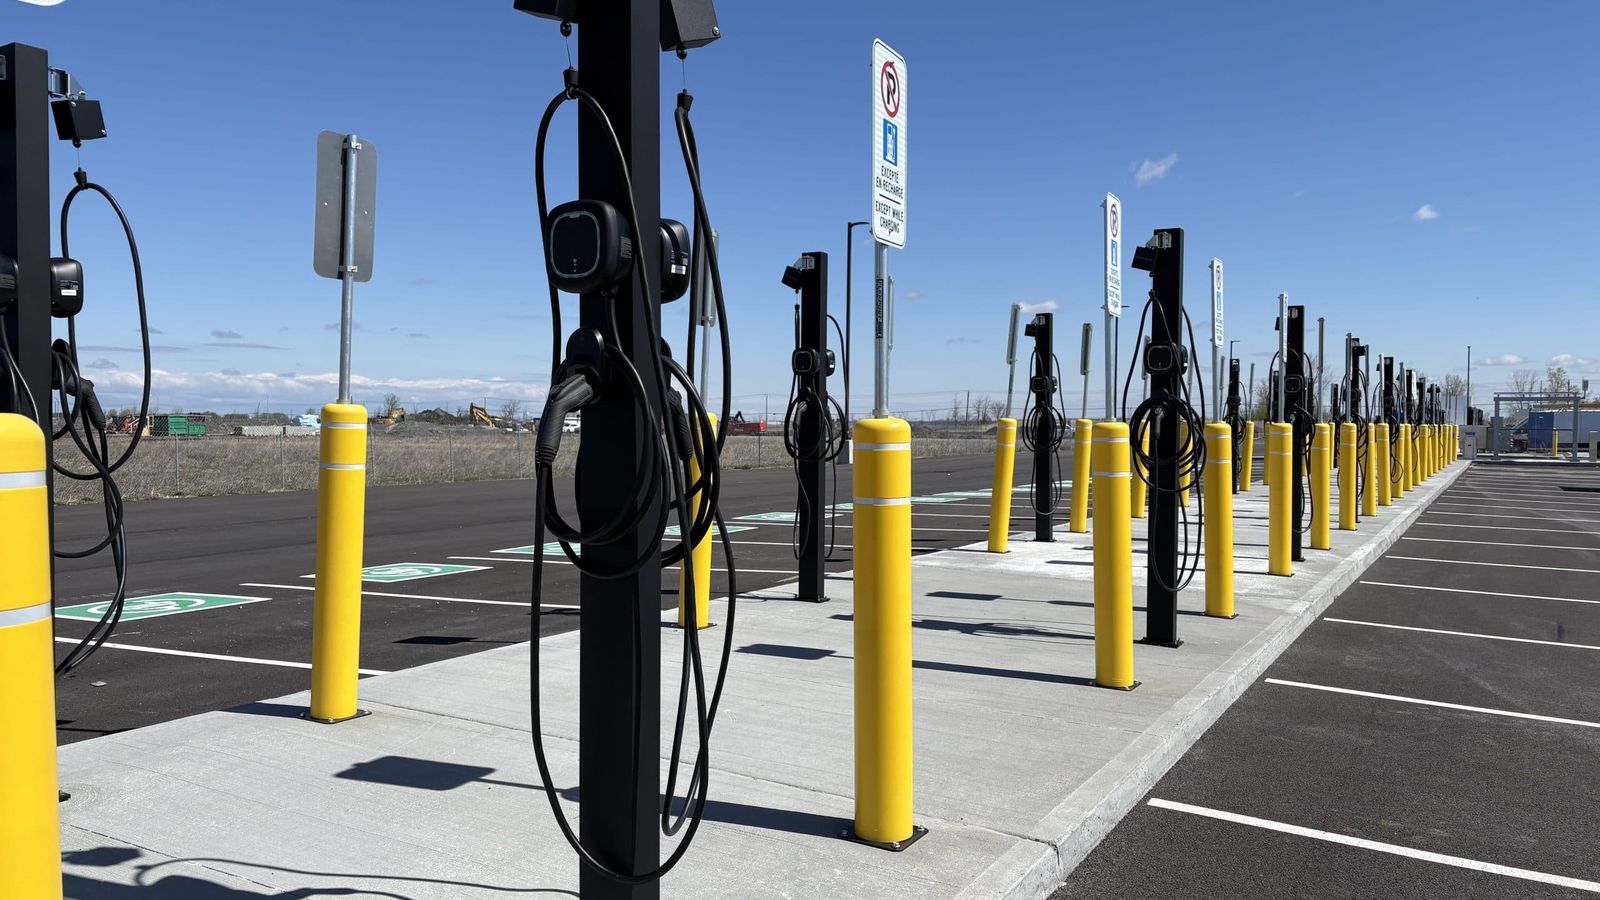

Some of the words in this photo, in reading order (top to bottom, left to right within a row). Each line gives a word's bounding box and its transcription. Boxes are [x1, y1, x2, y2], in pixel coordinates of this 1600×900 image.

[881, 165, 899, 184] EXCEPTÉ
[876, 176, 882, 189] EN
[883, 179, 904, 199] RECHARGE
[875, 200, 891, 216] EXCEPT
[892, 207, 904, 223] WHILE
[880, 216, 900, 233] CHARGING
